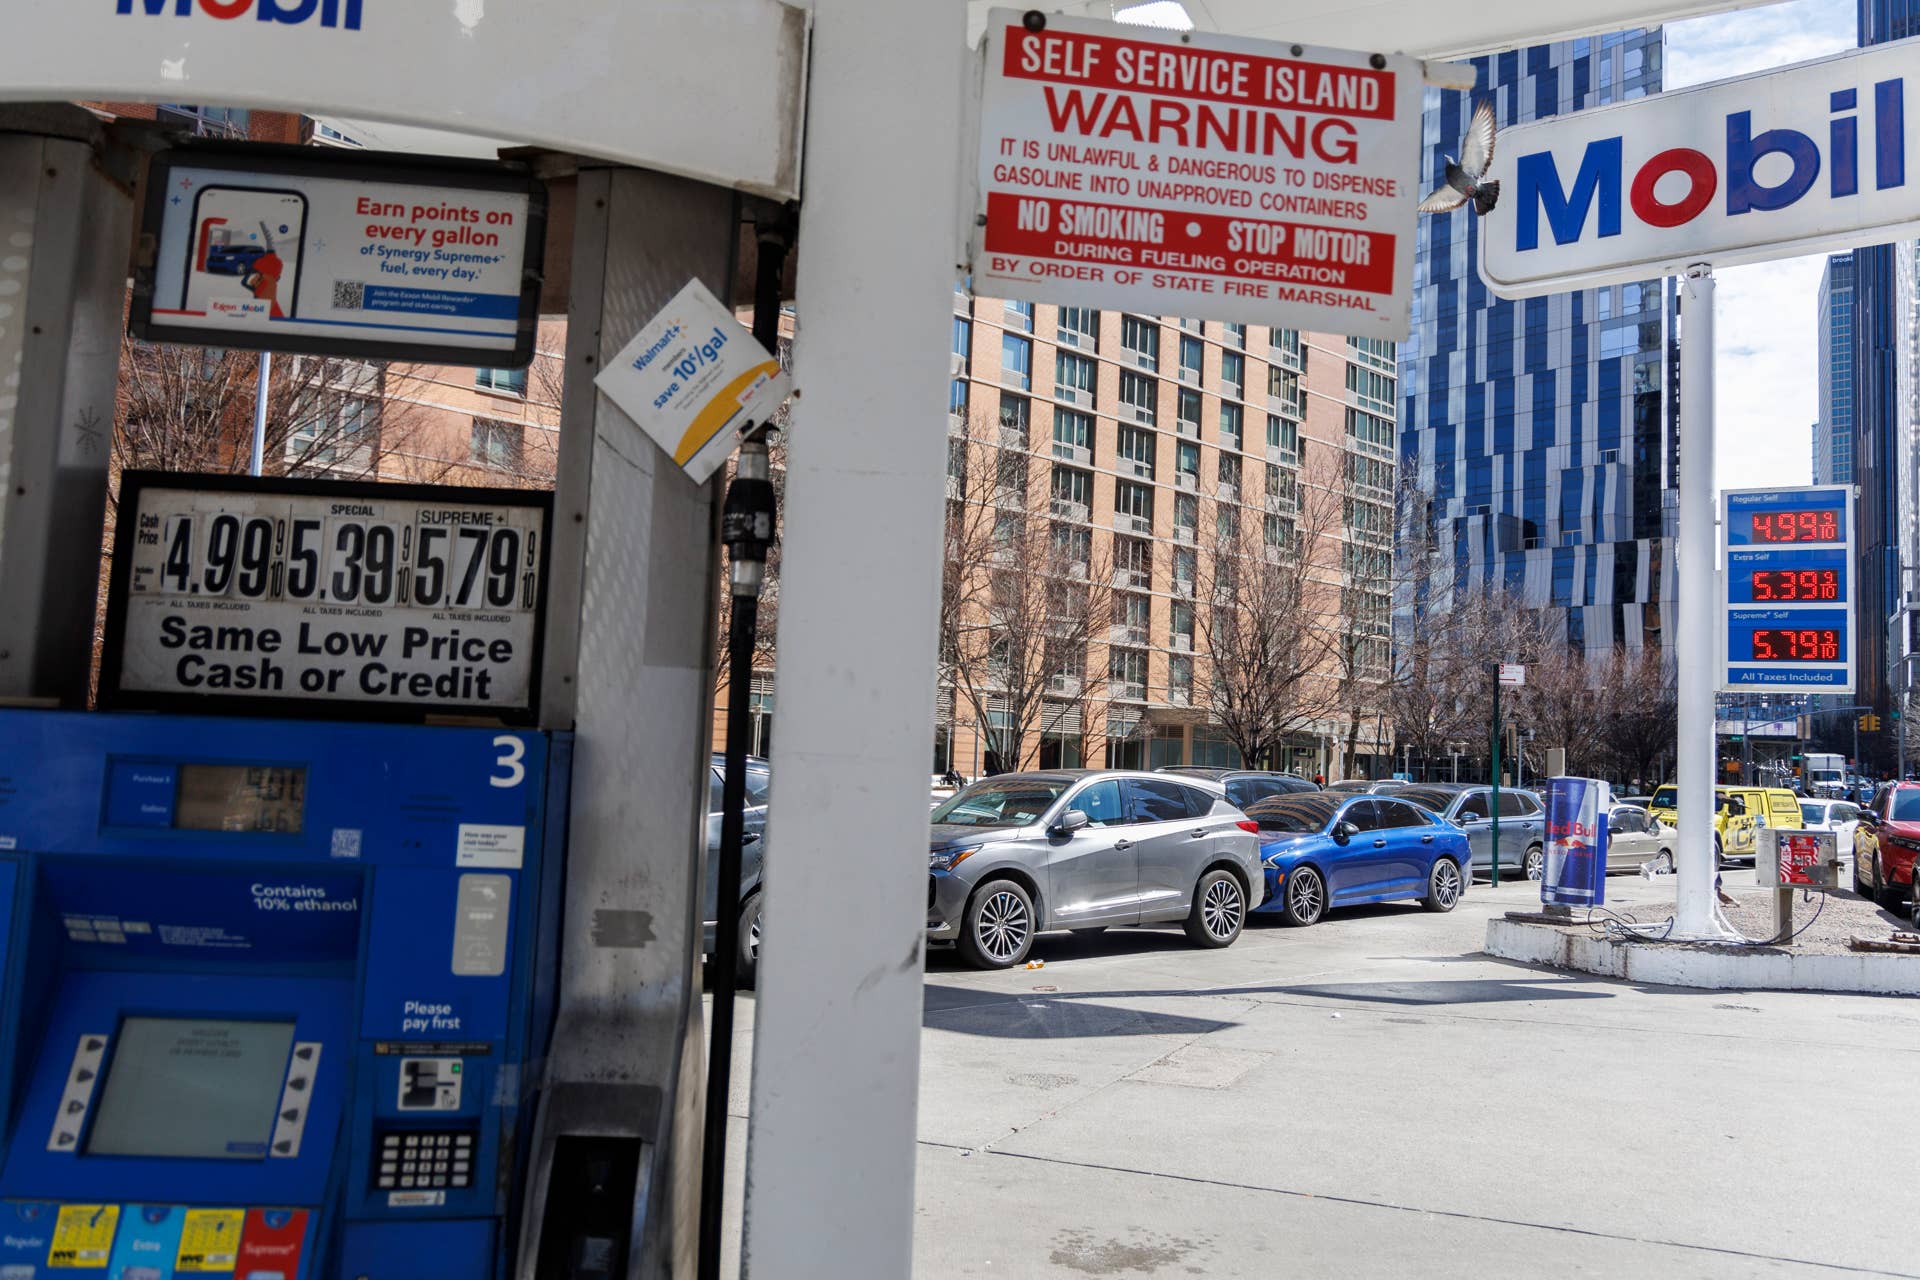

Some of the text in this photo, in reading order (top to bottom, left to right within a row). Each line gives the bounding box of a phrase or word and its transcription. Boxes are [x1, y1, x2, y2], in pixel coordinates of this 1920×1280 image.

[1021, 36, 1379, 111] SELF SERVICE ISLAND
[1043, 86, 1358, 164] WARNING
[1000, 138, 1396, 197] IT IS UNLAWFUL & DANGEROUS TO DISPENSE
[1516, 77, 1905, 252] Mobil
[994, 165, 1367, 220] GASOLINE INTO UNAPPROVED CONTAINERS
[356, 196, 513, 226] Earn points on
[365, 224, 499, 248] every gallon
[1018, 200, 1370, 266] NO SMOKING STOP MOTOR
[360, 244, 374, 256] of
[377, 246, 429, 262] Synergy
[1054, 240, 1346, 285] DURING FUELING OPERATION
[381, 262, 409, 277] fuel,
[412, 265, 448, 279] every
[992, 257, 1019, 272] BY
[1029, 261, 1104, 282] ORDER
[1114, 269, 1143, 285] OF
[1153, 274, 1214, 293] STATE
[1223, 281, 1268, 299] FIRE
[1278, 287, 1376, 311] MARSHAL
[653, 382, 680, 409] save
[331, 504, 375, 516] SPECIAL
[1733, 493, 1778, 503] Regular Self
[140, 513, 159, 528] Cash
[421, 510, 493, 525] SUPREME
[1753, 512, 1817, 541] 4.99
[138, 530, 158, 545] Price
[167, 515, 273, 598] 4.99
[288, 521, 394, 604] 5.39
[415, 528, 519, 607] 5.79
[1755, 553, 1770, 561] Self
[1753, 571, 1818, 600] 5.39
[170, 601, 184, 609] ALL
[187, 601, 210, 610] TAXES
[213, 602, 250, 611] INCLUDED
[303, 607, 383, 617] ALL TAXES INCLUDED
[448, 613, 471, 622] TAXES
[474, 614, 511, 623] INCLUDED
[1773, 611, 1789, 619] Self
[160, 616, 514, 664] Same Low Price
[1753, 631, 1818, 659] 5.79
[176, 653, 492, 701] Cash or Credit
[1741, 673, 1833, 682] All Taxes Included
[488, 735, 526, 788] 3
[1573, 822, 1596, 837] Bull
[251, 883, 325, 898] Contains
[254, 898, 357, 911] 10% ethanol
[404, 1001, 451, 1015] Please
[403, 1016, 460, 1032] pay first
